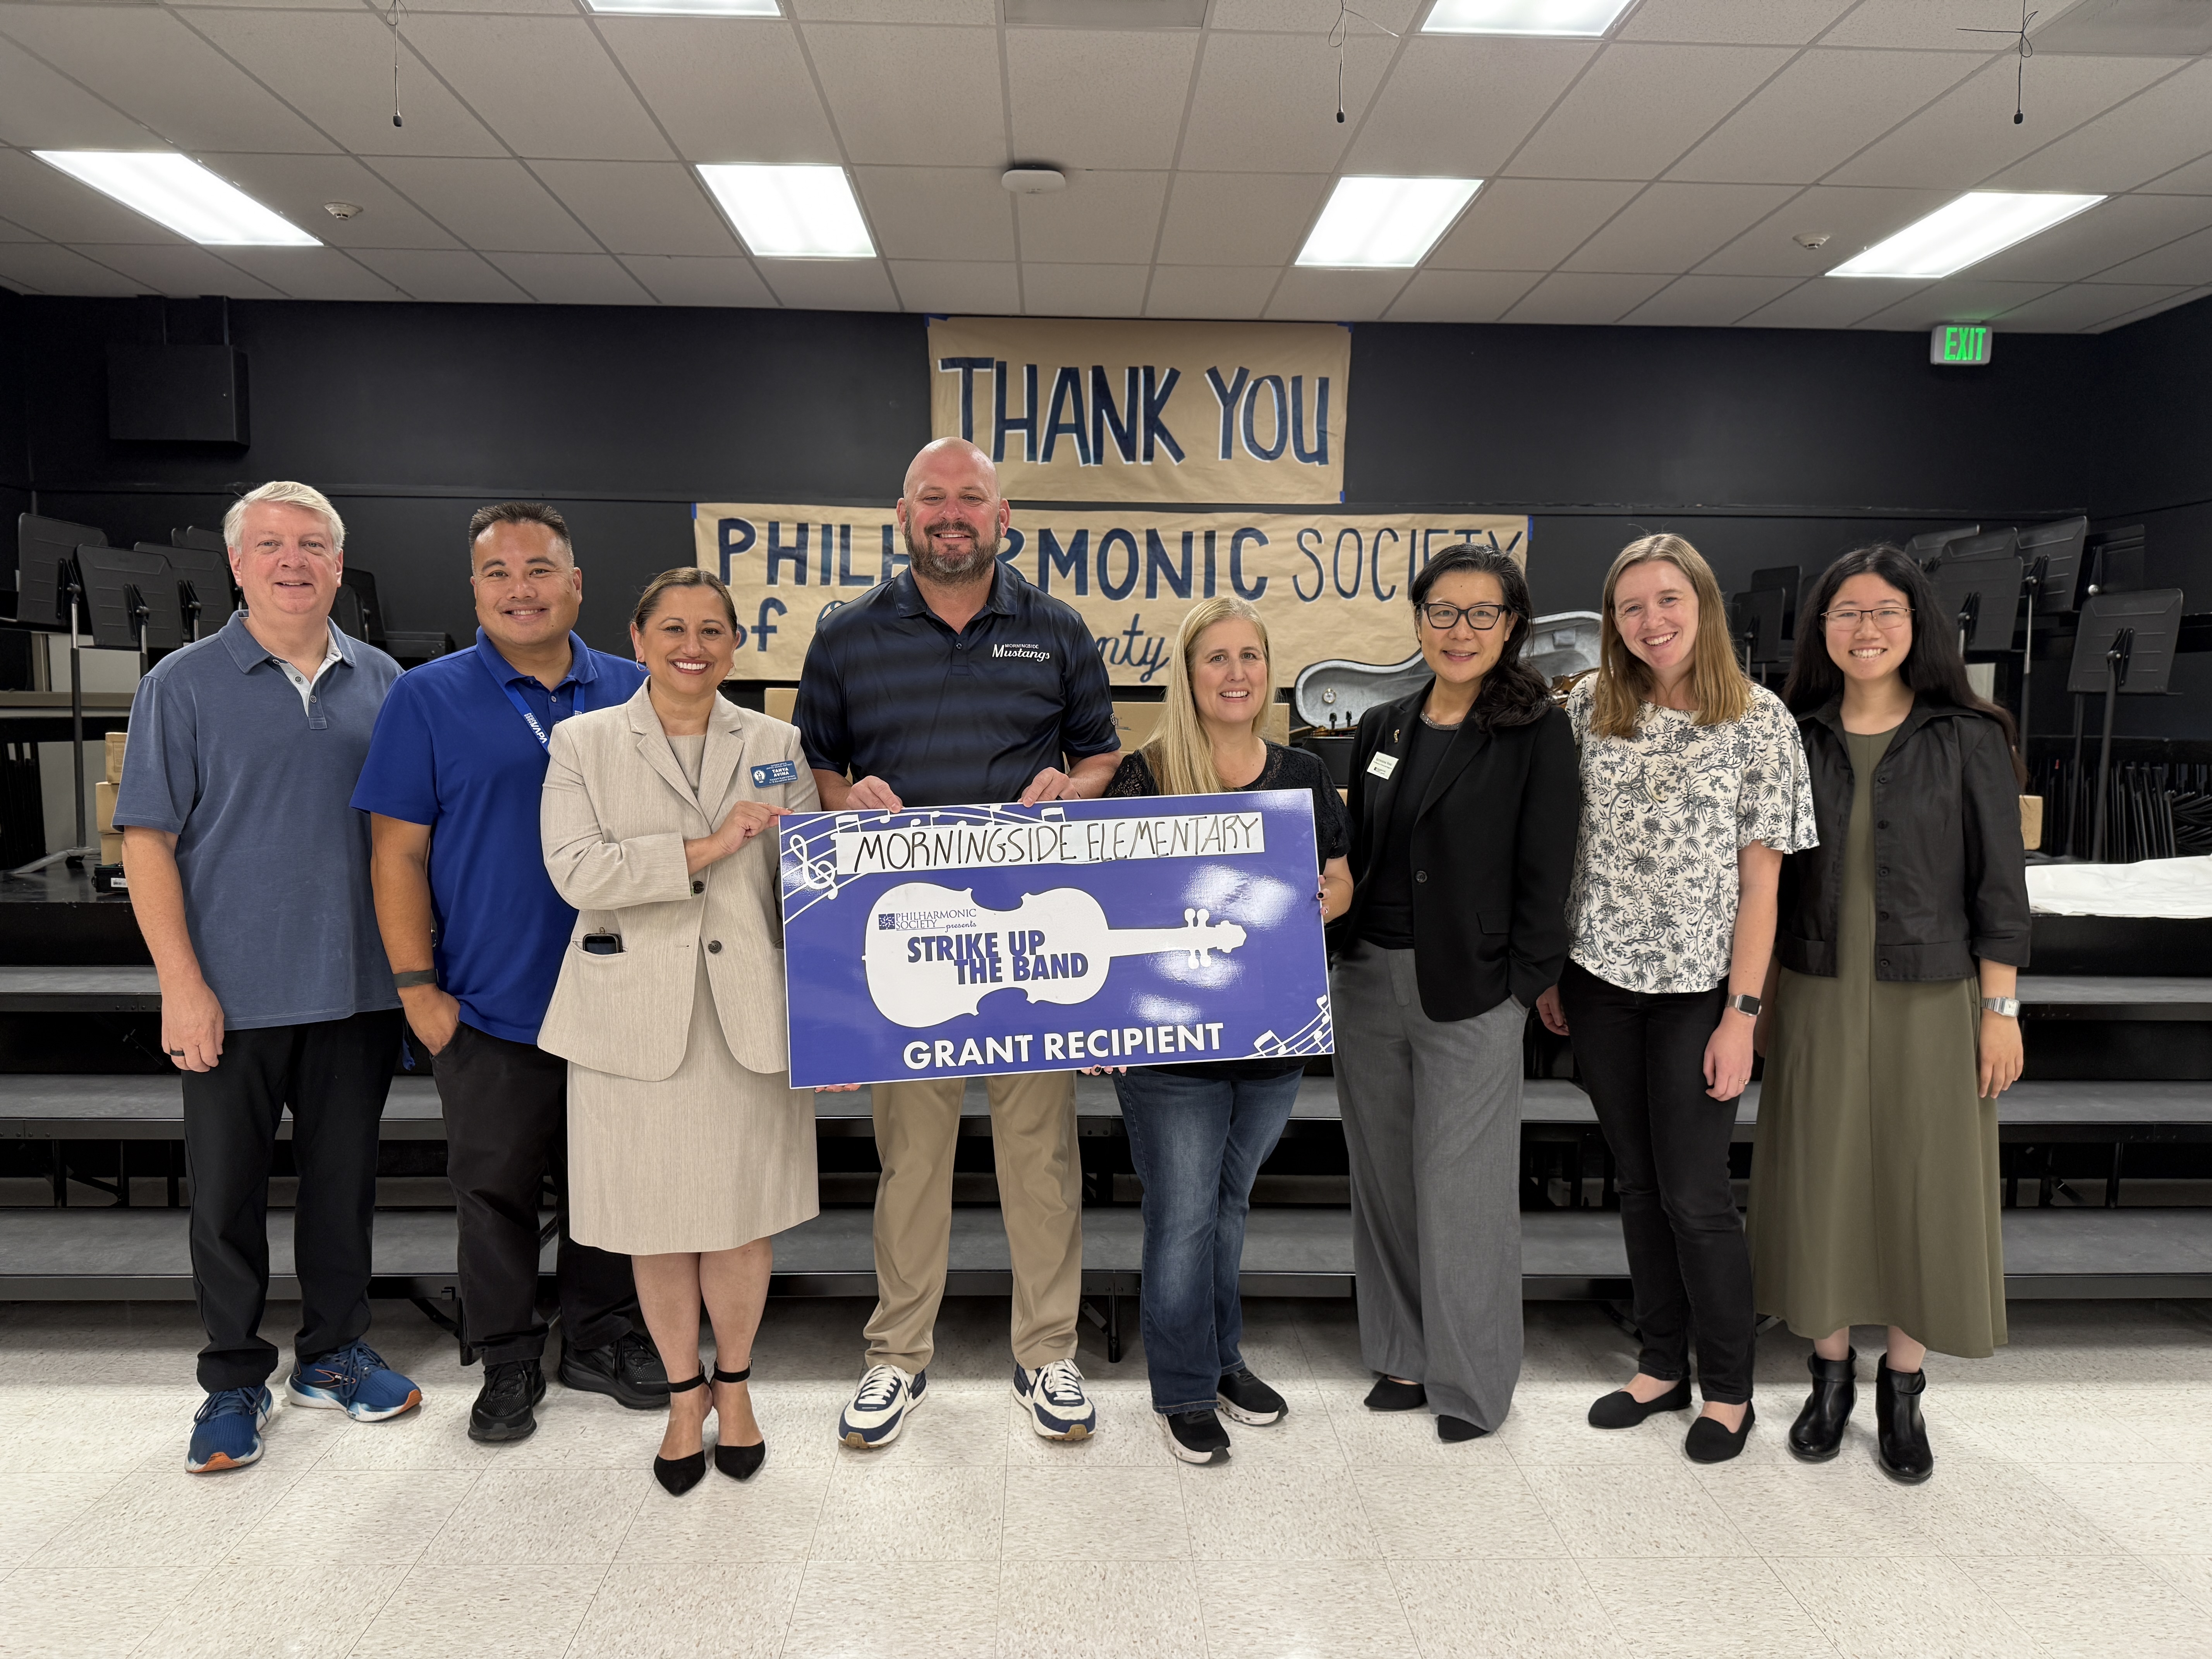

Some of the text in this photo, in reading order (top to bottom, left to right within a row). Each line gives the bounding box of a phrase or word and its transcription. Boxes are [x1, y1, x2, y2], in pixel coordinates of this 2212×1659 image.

[1944, 327, 1987, 361] EXIT
[938, 357, 1329, 467] THANK YOU
[718, 517, 1270, 601] PHILHRMONIC
[992, 644, 1050, 662] Mustangs
[854, 815, 1259, 873] MORNINGSIDE ELEMENTARY
[896, 908, 977, 921] PHILHARMONIC
[896, 919, 977, 933] SOCIETY presents
[907, 930, 1045, 963] STRIKE UP
[953, 952, 1089, 985] THE BAND
[903, 1022, 1224, 1070] GRANT RECIPIENT
